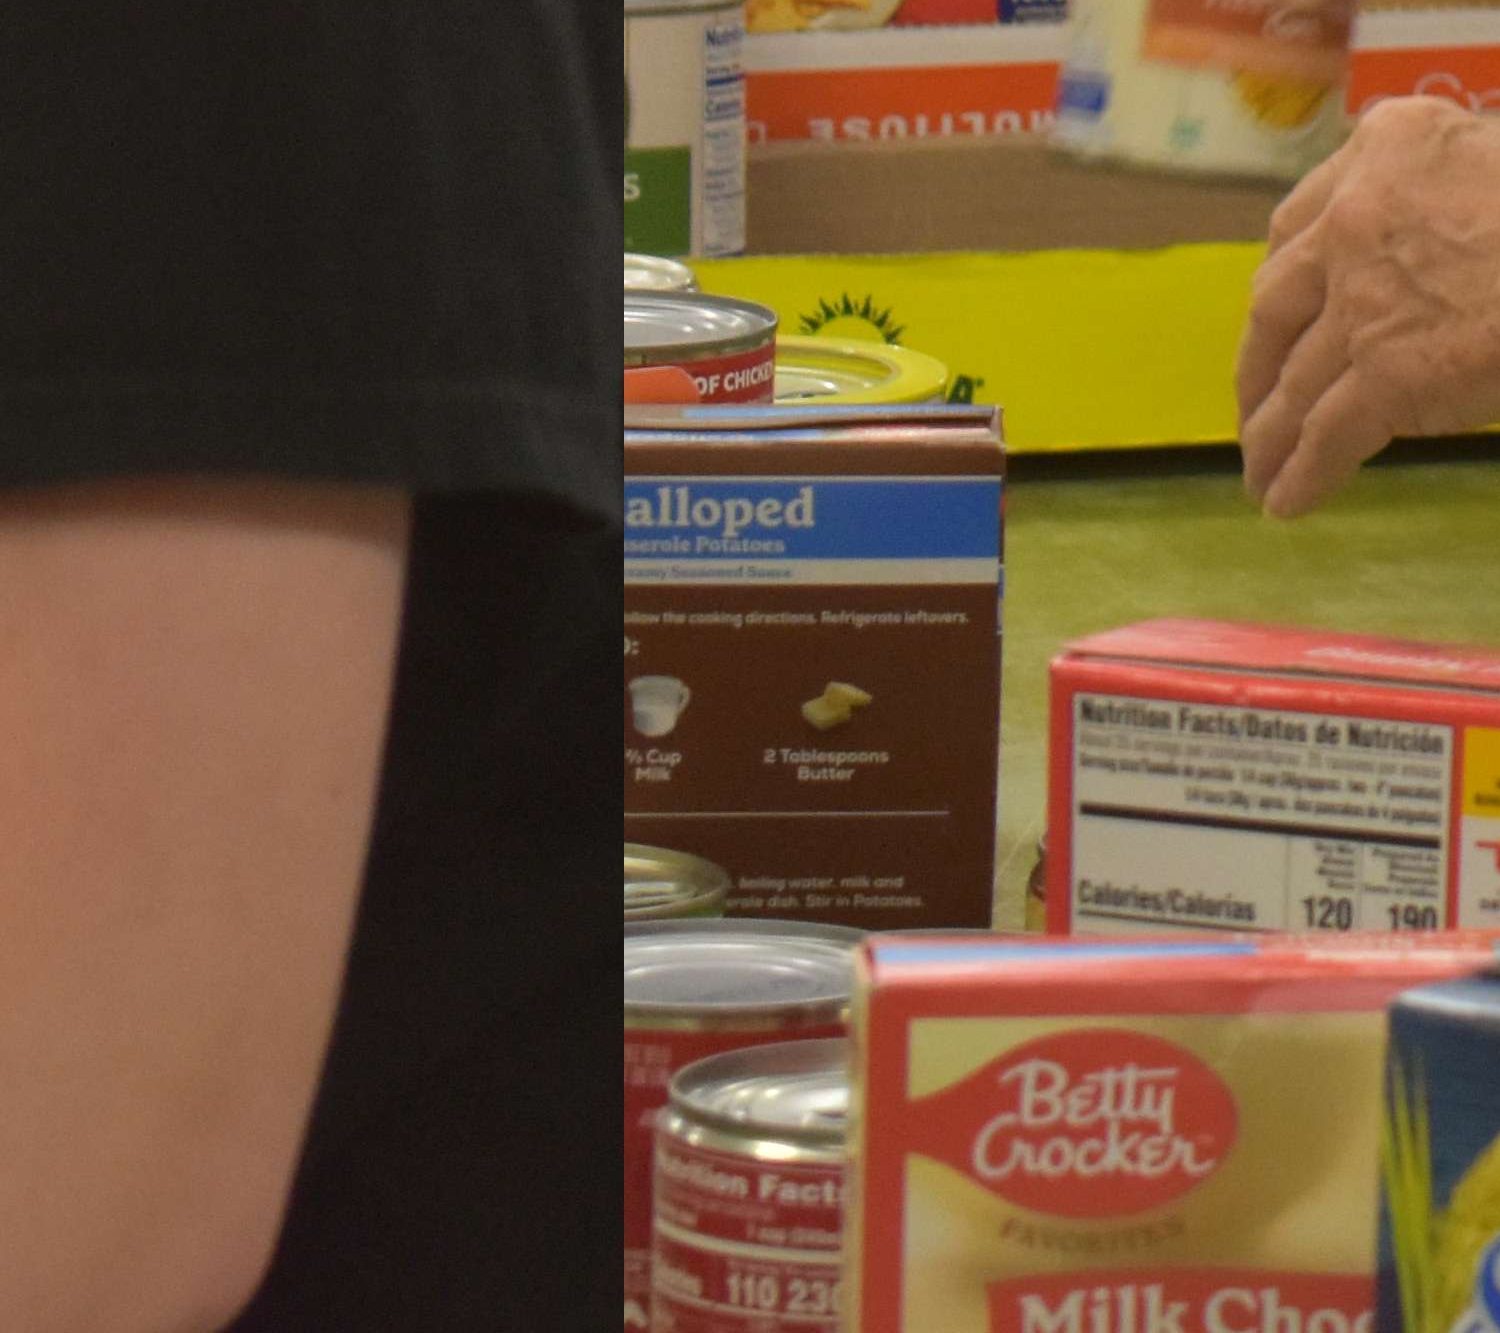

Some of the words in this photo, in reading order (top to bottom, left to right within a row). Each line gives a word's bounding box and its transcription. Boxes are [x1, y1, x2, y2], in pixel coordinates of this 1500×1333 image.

[694, 374, 720, 396] OF
[695, 536, 786, 553] Potatoes
[1078, 696, 1173, 734] Nutrition
[646, 748, 683, 768] Cup
[762, 748, 777, 765] 2
[780, 748, 890, 768] Tablespoons
[635, 767, 672, 782] Milk
[796, 765, 856, 782] Butter
[1302, 895, 1356, 932] 120
[1387, 903, 1438, 932] 190
[1000, 1057, 1181, 1131] Betty
[972, 1112, 1215, 1179] Crocker
[725, 1273, 779, 1311] 110
[1018, 1283, 1188, 1333] Milk
